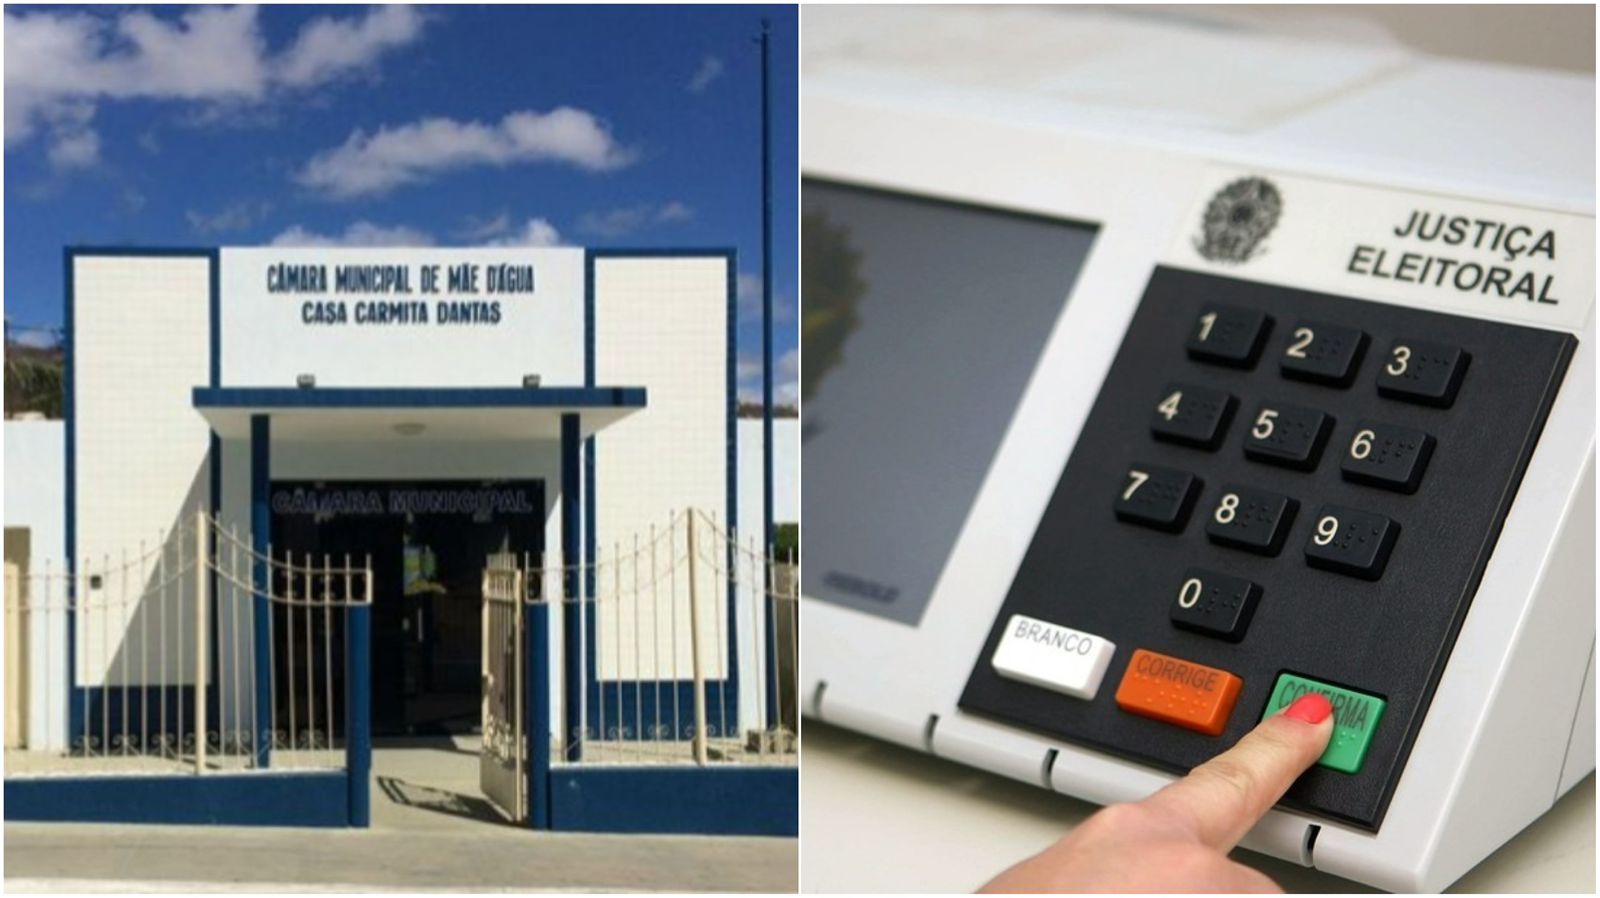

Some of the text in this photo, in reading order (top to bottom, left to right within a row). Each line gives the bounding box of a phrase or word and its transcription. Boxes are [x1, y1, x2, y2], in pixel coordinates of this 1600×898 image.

[1395, 211, 1556, 260] JUSTIÇA
[267, 261, 327, 293] CÂMARA
[335, 265, 413, 293] MUNICIPAL
[421, 266, 440, 293] DE
[448, 264, 479, 293] MÃE
[1347, 245, 1560, 305] ELEITORAL
[302, 302, 501, 324] CASA CARMITA DANTAS
[1199, 312, 1218, 341] 1
[1287, 328, 1314, 358] 2
[1387, 346, 1411, 376] 3
[1157, 391, 1183, 421] 4
[1252, 409, 1279, 439] 5
[1350, 430, 1375, 459] 6
[1122, 470, 1149, 501] 7
[389, 490, 532, 514] MUNICIPAL
[1215, 493, 1239, 523] 8
[1314, 515, 1339, 546] 9
[1178, 578, 1202, 608] 0
[1013, 619, 1094, 657] BRANCO
[1136, 654, 1219, 693] CORRIGE
